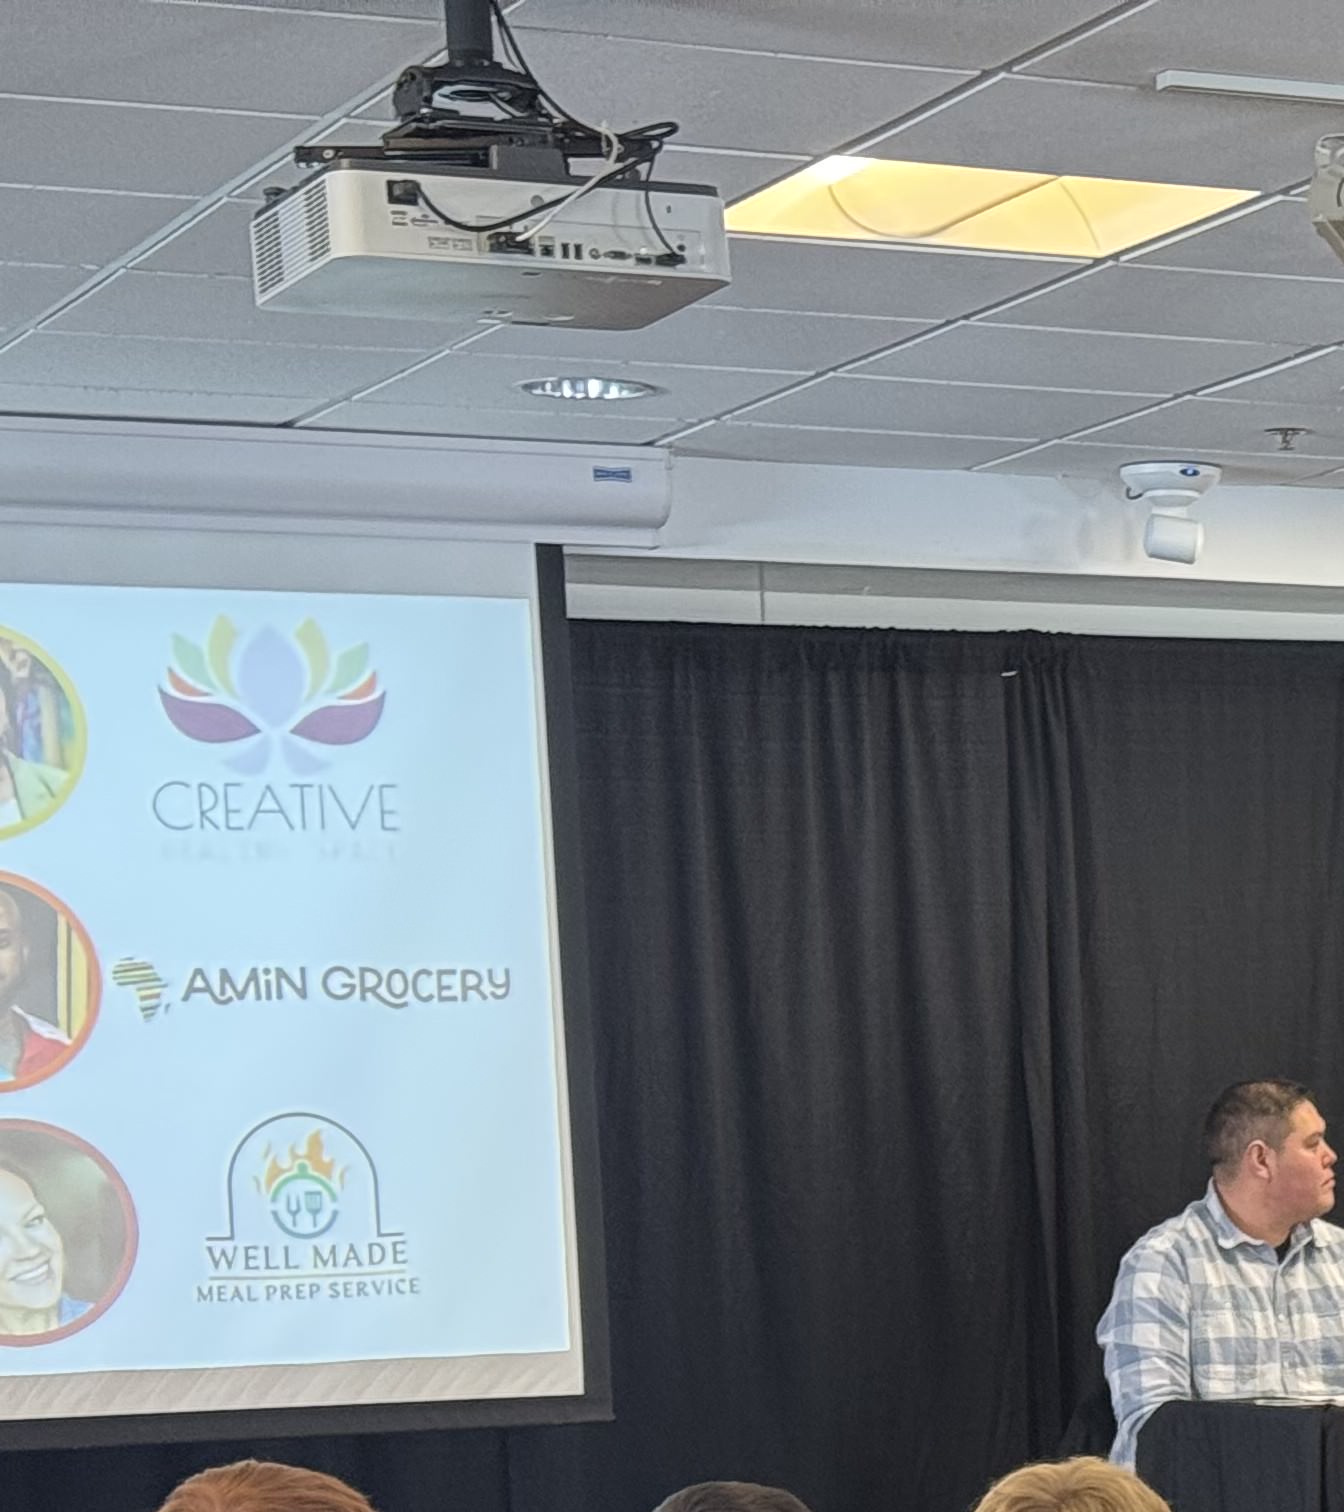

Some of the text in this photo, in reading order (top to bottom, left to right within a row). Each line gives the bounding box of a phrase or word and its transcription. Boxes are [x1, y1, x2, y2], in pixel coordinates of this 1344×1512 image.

[152, 780, 400, 831] CREATIVE
[321, 965, 512, 1010] GROCERY
[205, 1239, 408, 1271] WELL MADE
[196, 1276, 421, 1303] MEAL PREP SERVICE
